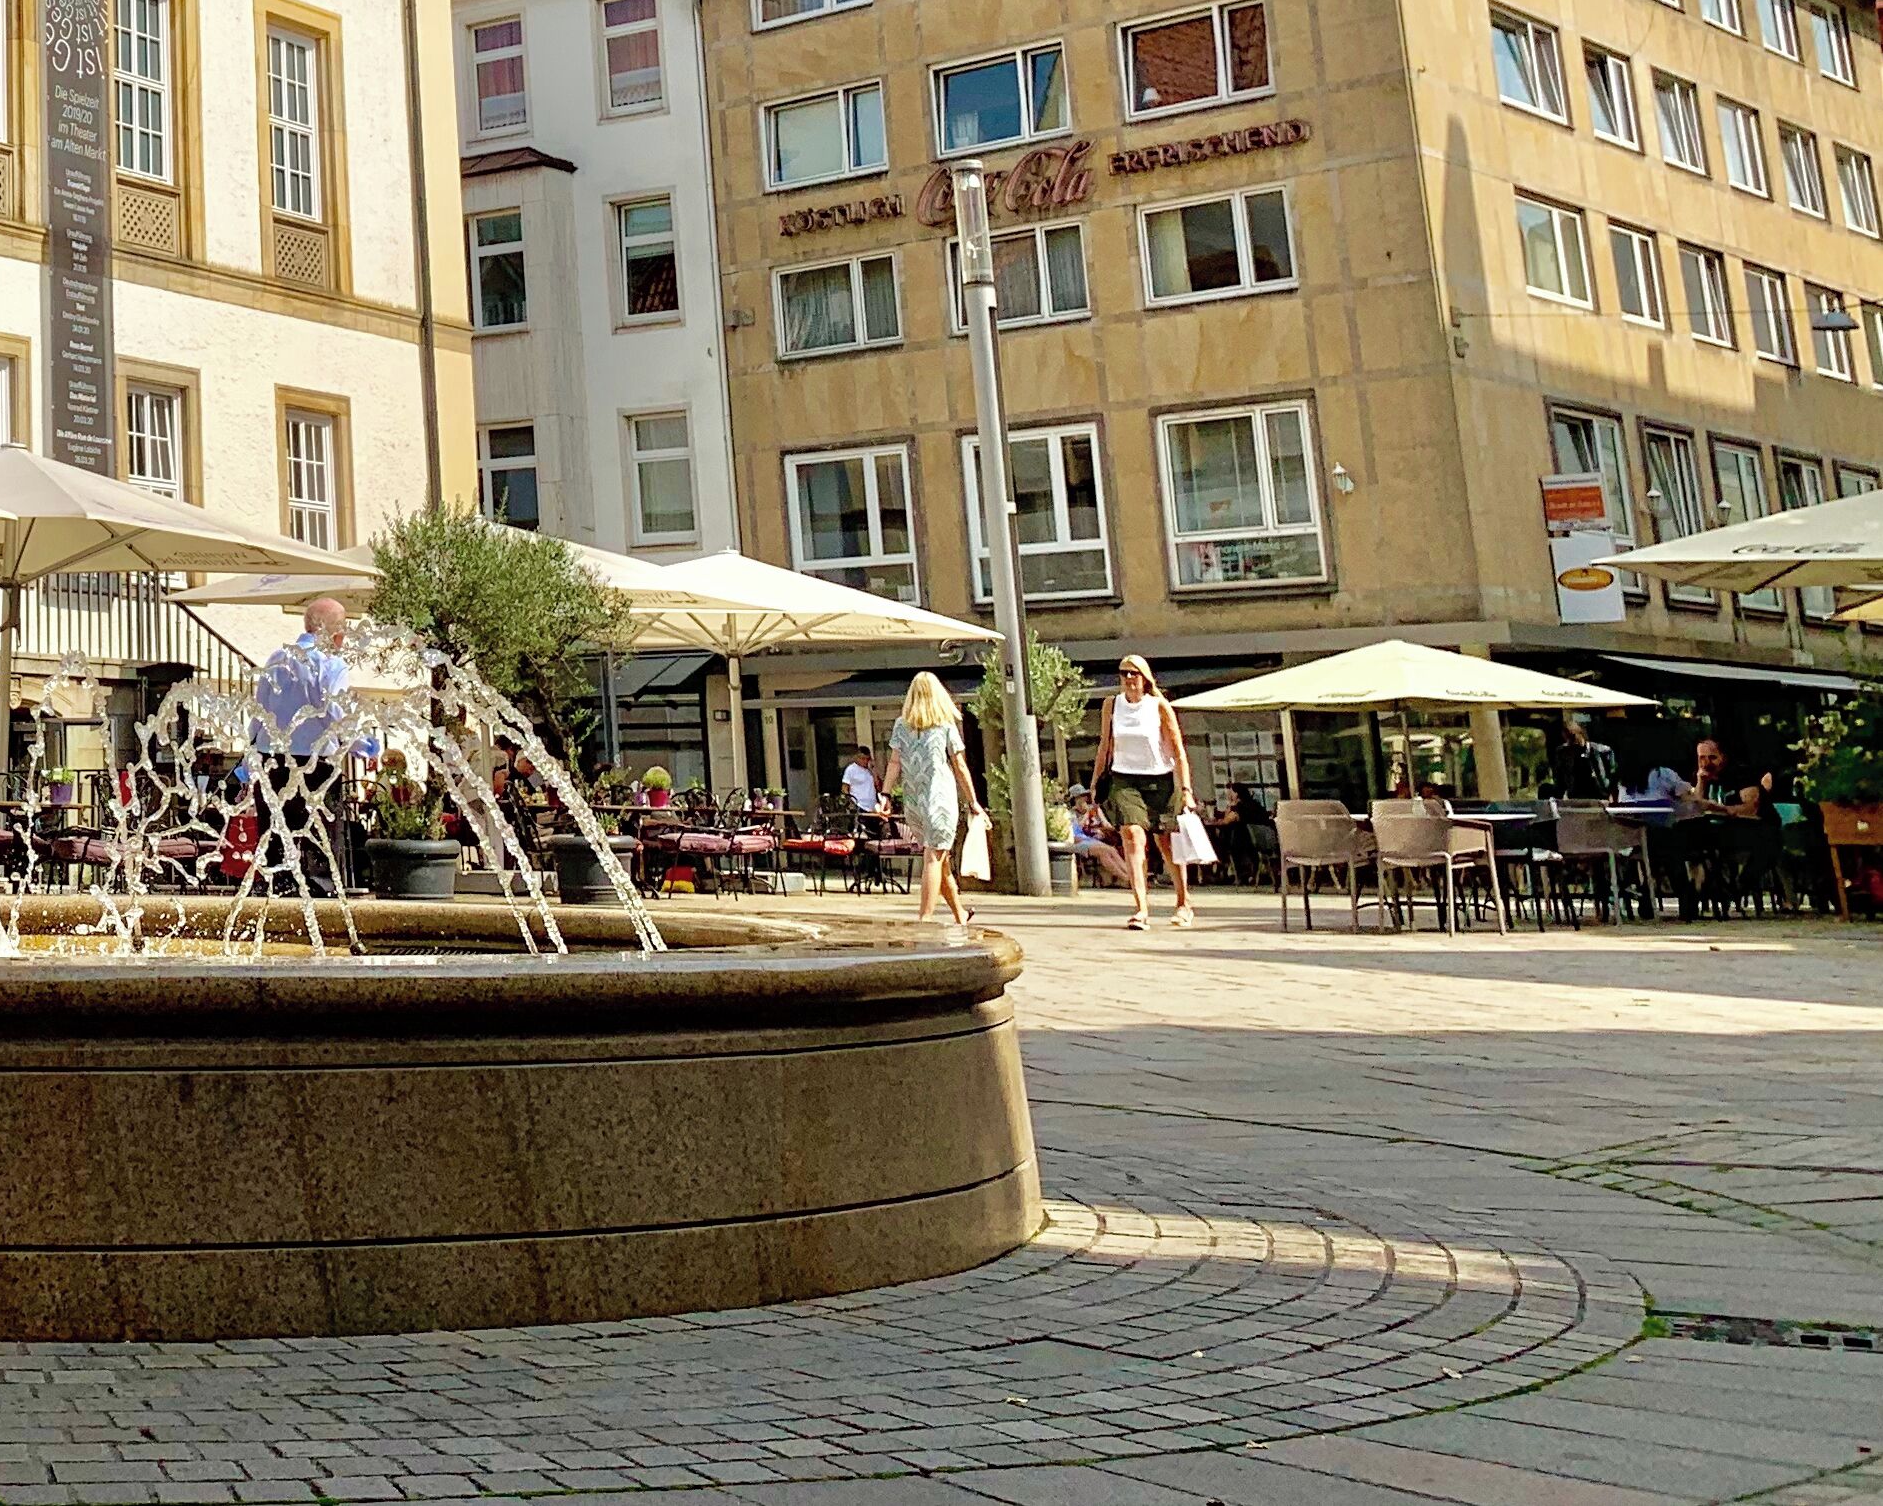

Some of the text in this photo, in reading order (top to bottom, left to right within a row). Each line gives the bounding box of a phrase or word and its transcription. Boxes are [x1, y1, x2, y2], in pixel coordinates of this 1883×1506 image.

[75, 23, 94, 46] ist
[76, 46, 105, 79] ist
[55, 84, 99, 110] Die Spielzeit
[62, 104, 93, 125] 2019/20
[58, 120, 98, 142] im Theater
[51, 137, 106, 161] am Alten Markt
[778, 194, 906, 237] KÖSTLICH
[1107, 118, 1312, 176] ERFRISCHEND
